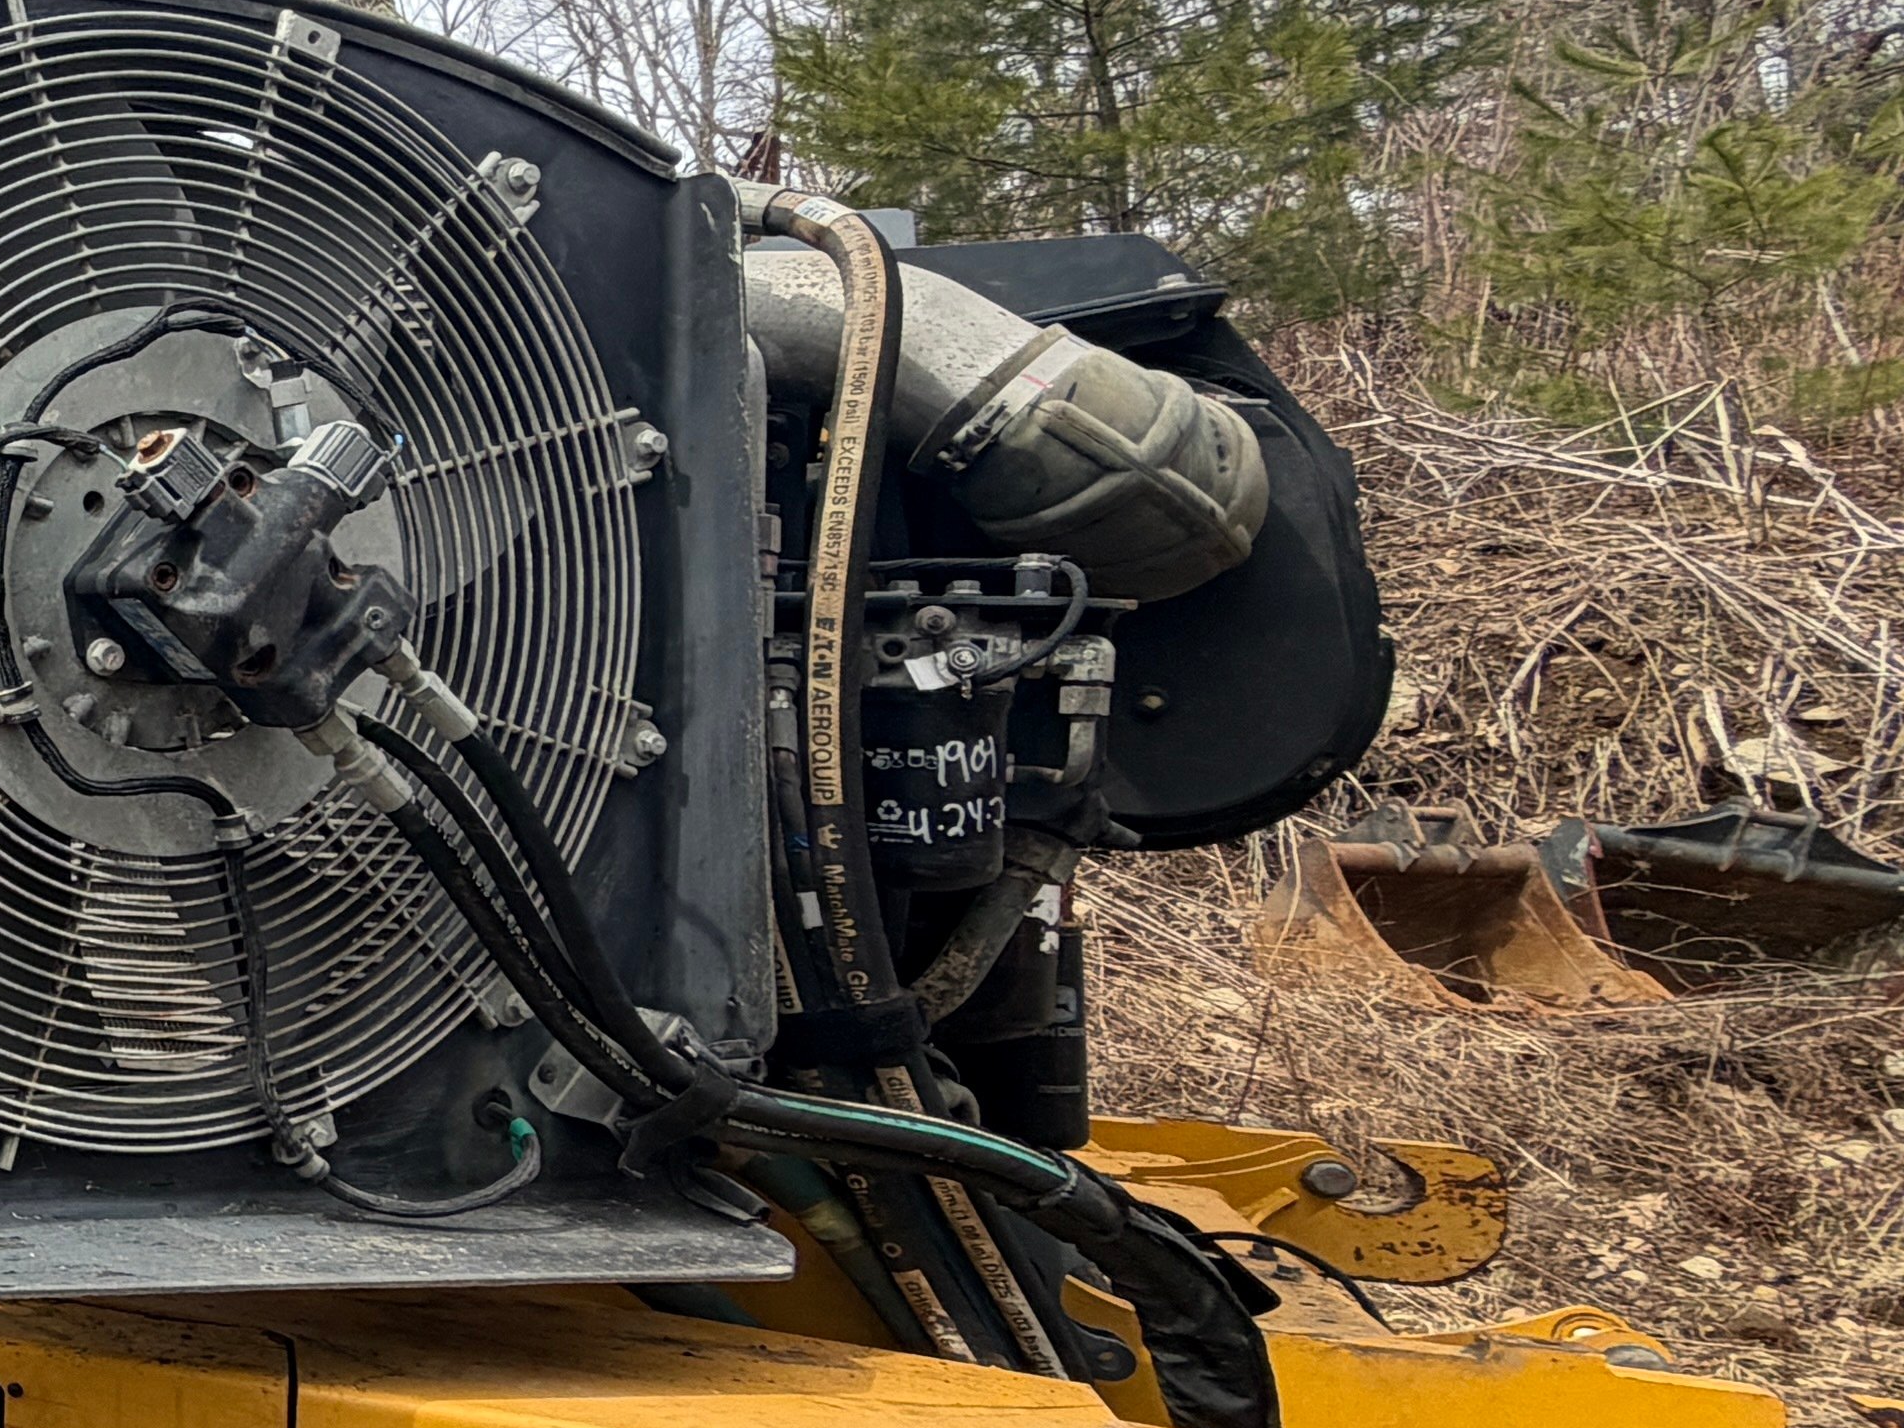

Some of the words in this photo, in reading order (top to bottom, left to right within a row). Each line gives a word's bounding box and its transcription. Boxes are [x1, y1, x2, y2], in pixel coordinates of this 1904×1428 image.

[849, 360, 871, 396] (1500
[831, 435, 857, 506] EXCEEDS
[811, 686, 835, 801] AEROQUIP
[822, 863, 858, 963] MatchMate
